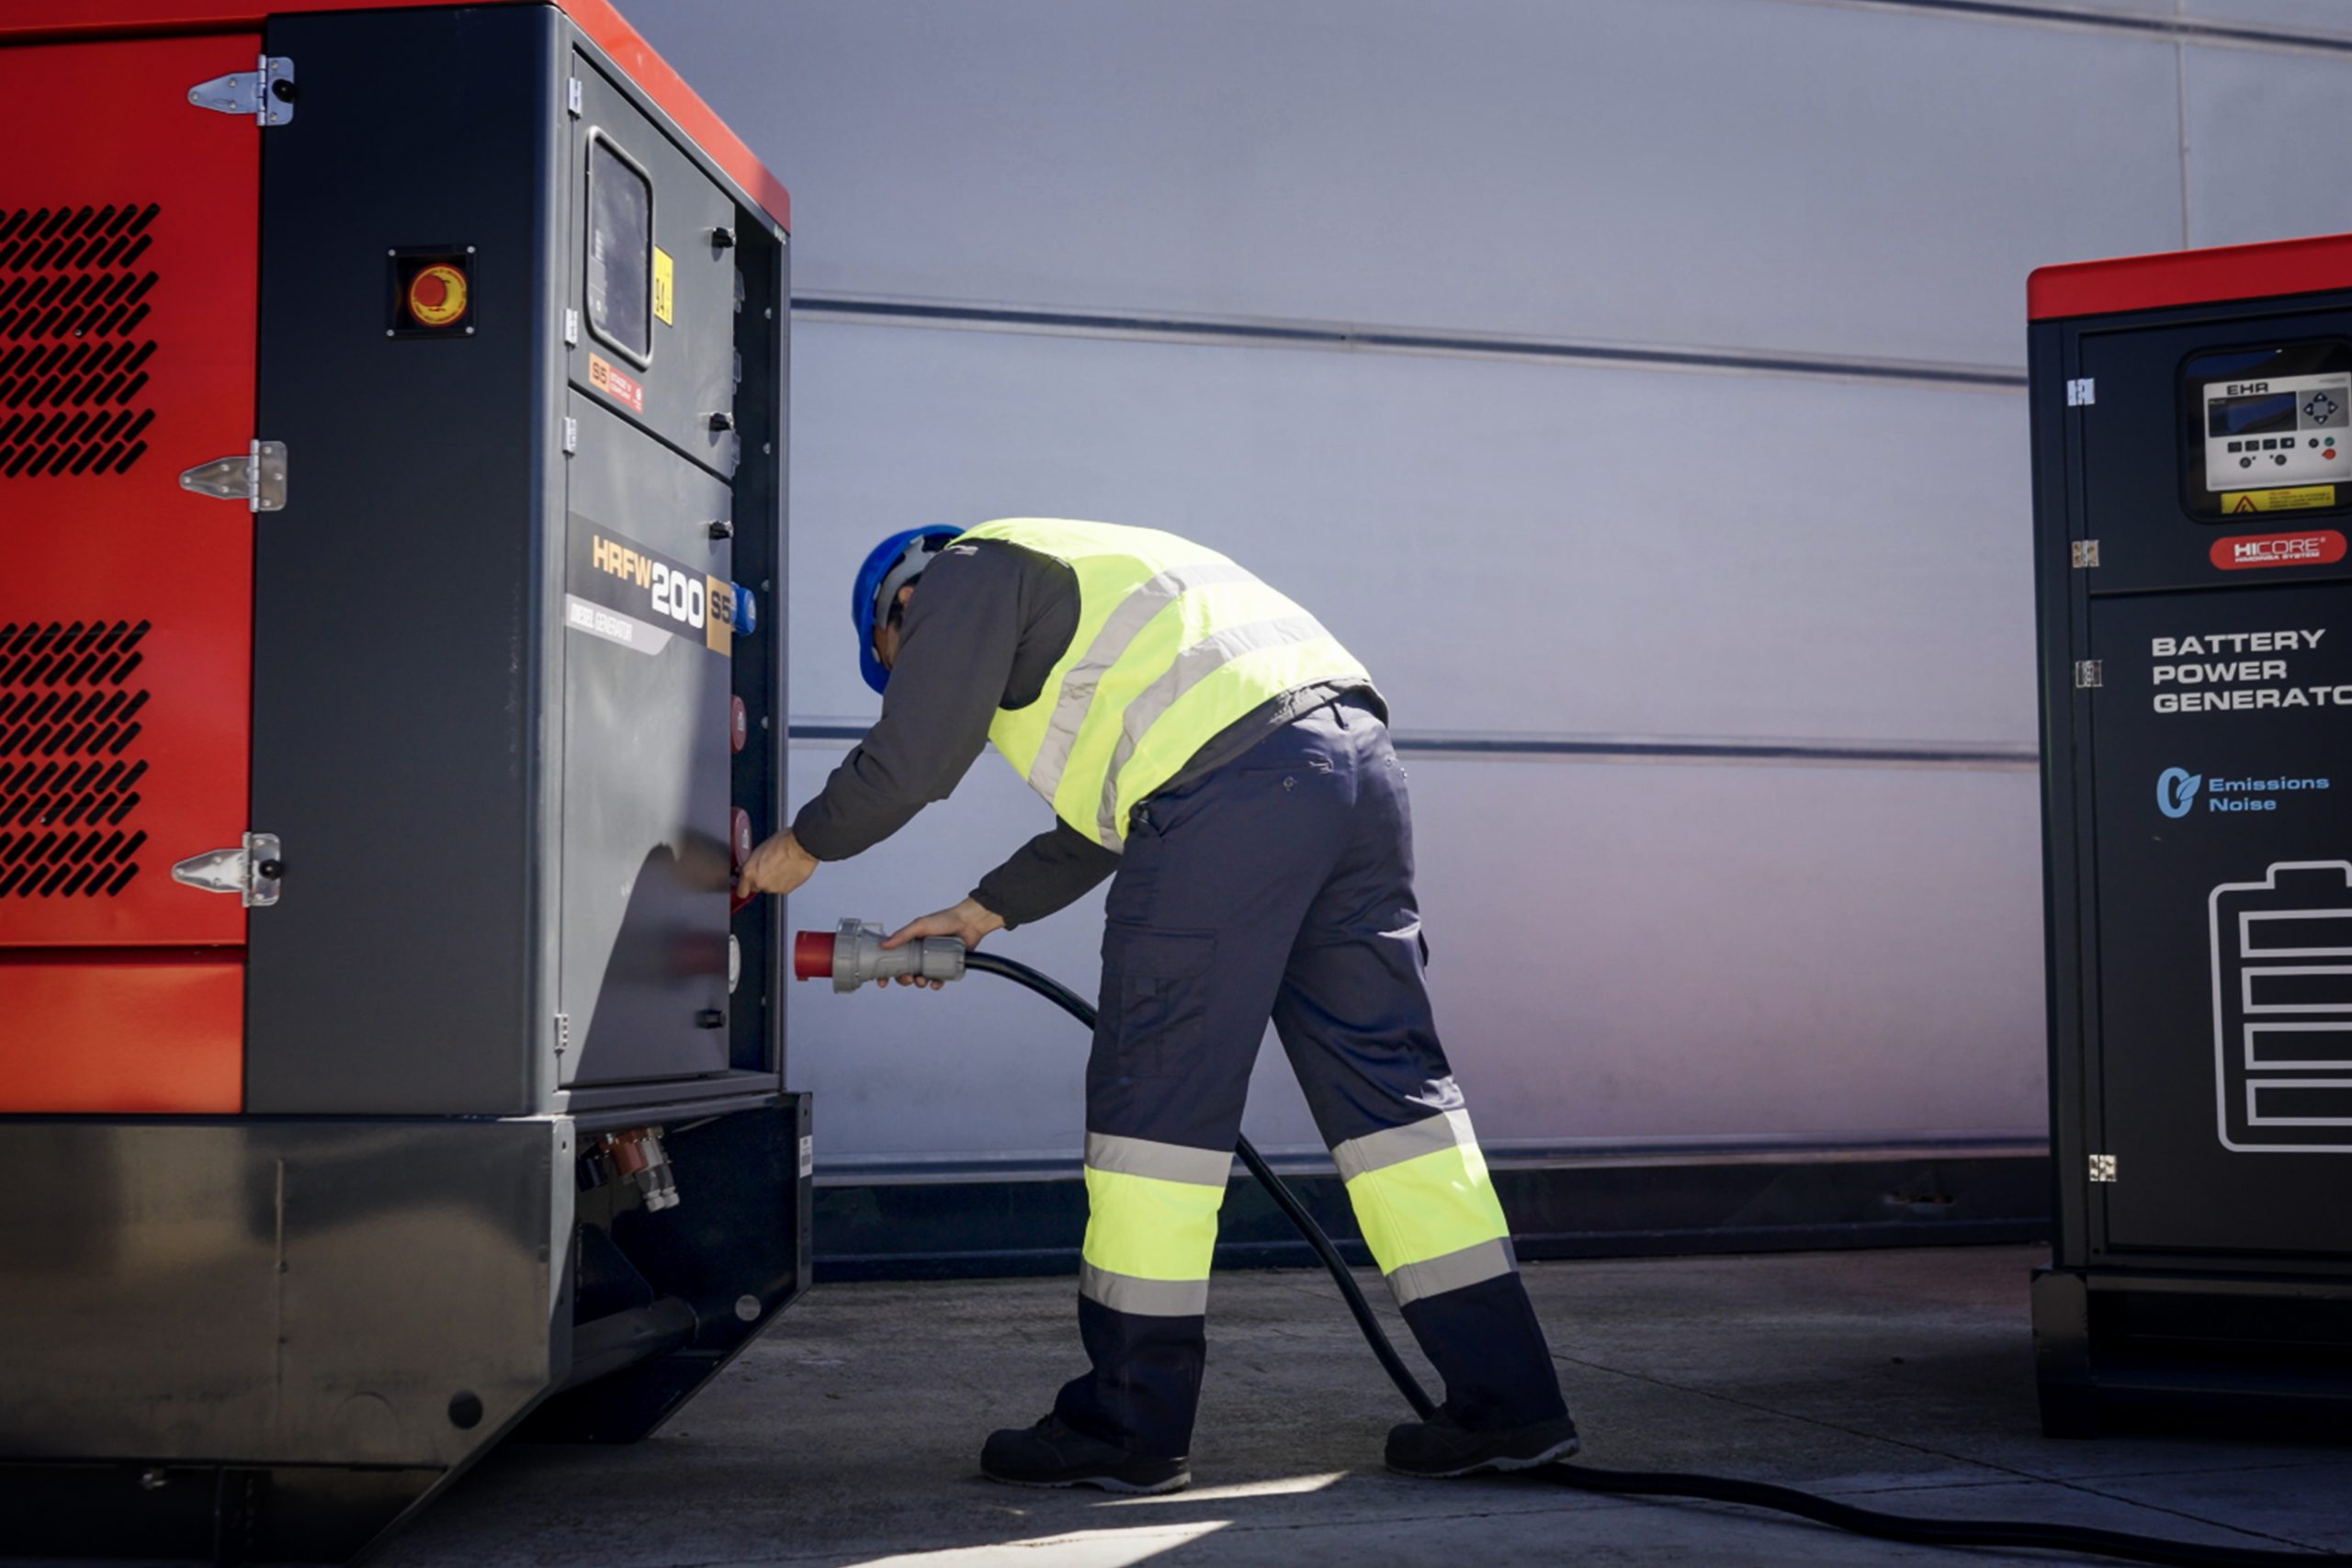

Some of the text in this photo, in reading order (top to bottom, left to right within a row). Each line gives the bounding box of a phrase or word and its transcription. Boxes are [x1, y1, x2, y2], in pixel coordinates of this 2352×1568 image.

[2227, 382, 2268, 395] EHR
[710, 590, 731, 624] S5
[2152, 629, 2325, 657] BATTERY
[2153, 660, 2287, 684] POWER
[2209, 776, 2330, 792] Emissions
[2210, 797, 2277, 812] Noise
